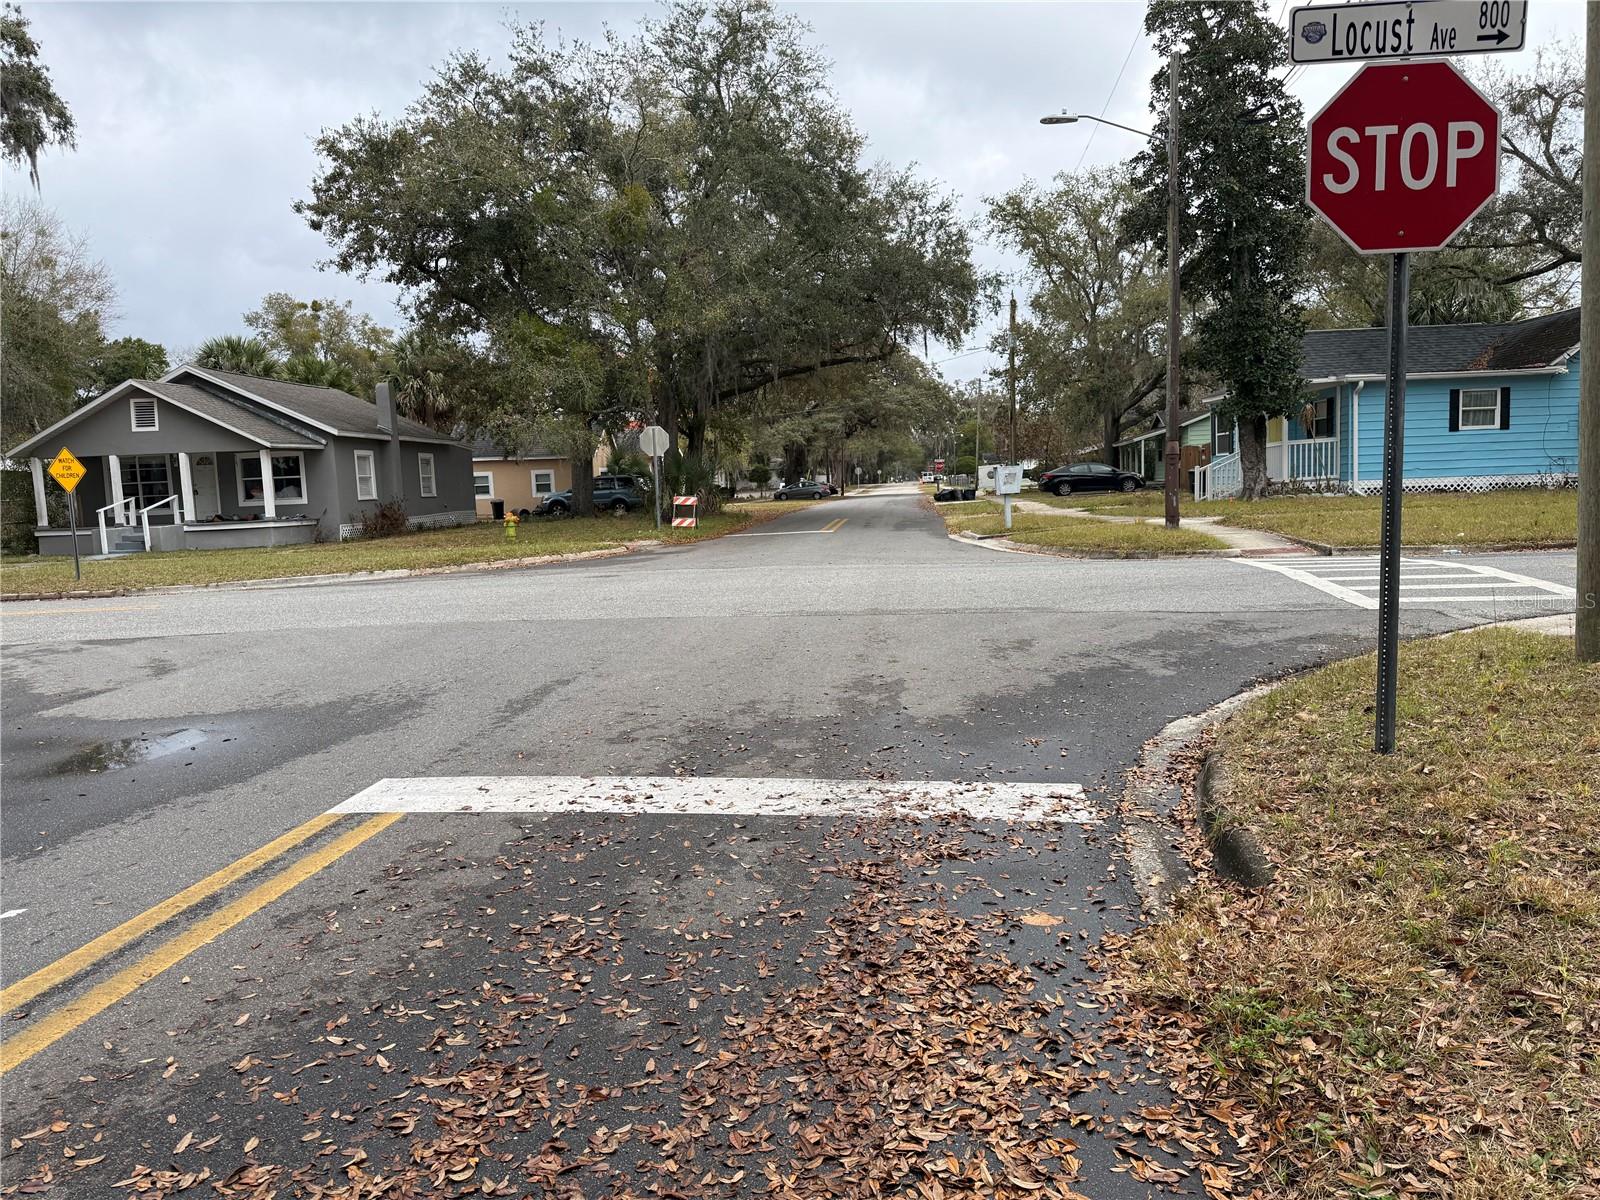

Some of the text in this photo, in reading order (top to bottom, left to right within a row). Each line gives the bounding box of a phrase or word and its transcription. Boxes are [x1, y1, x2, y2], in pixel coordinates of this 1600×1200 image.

[1332, 9, 1457, 56] Locust Ave
[1479, 0, 1510, 29] 800
[1322, 121, 1485, 195] STOP
